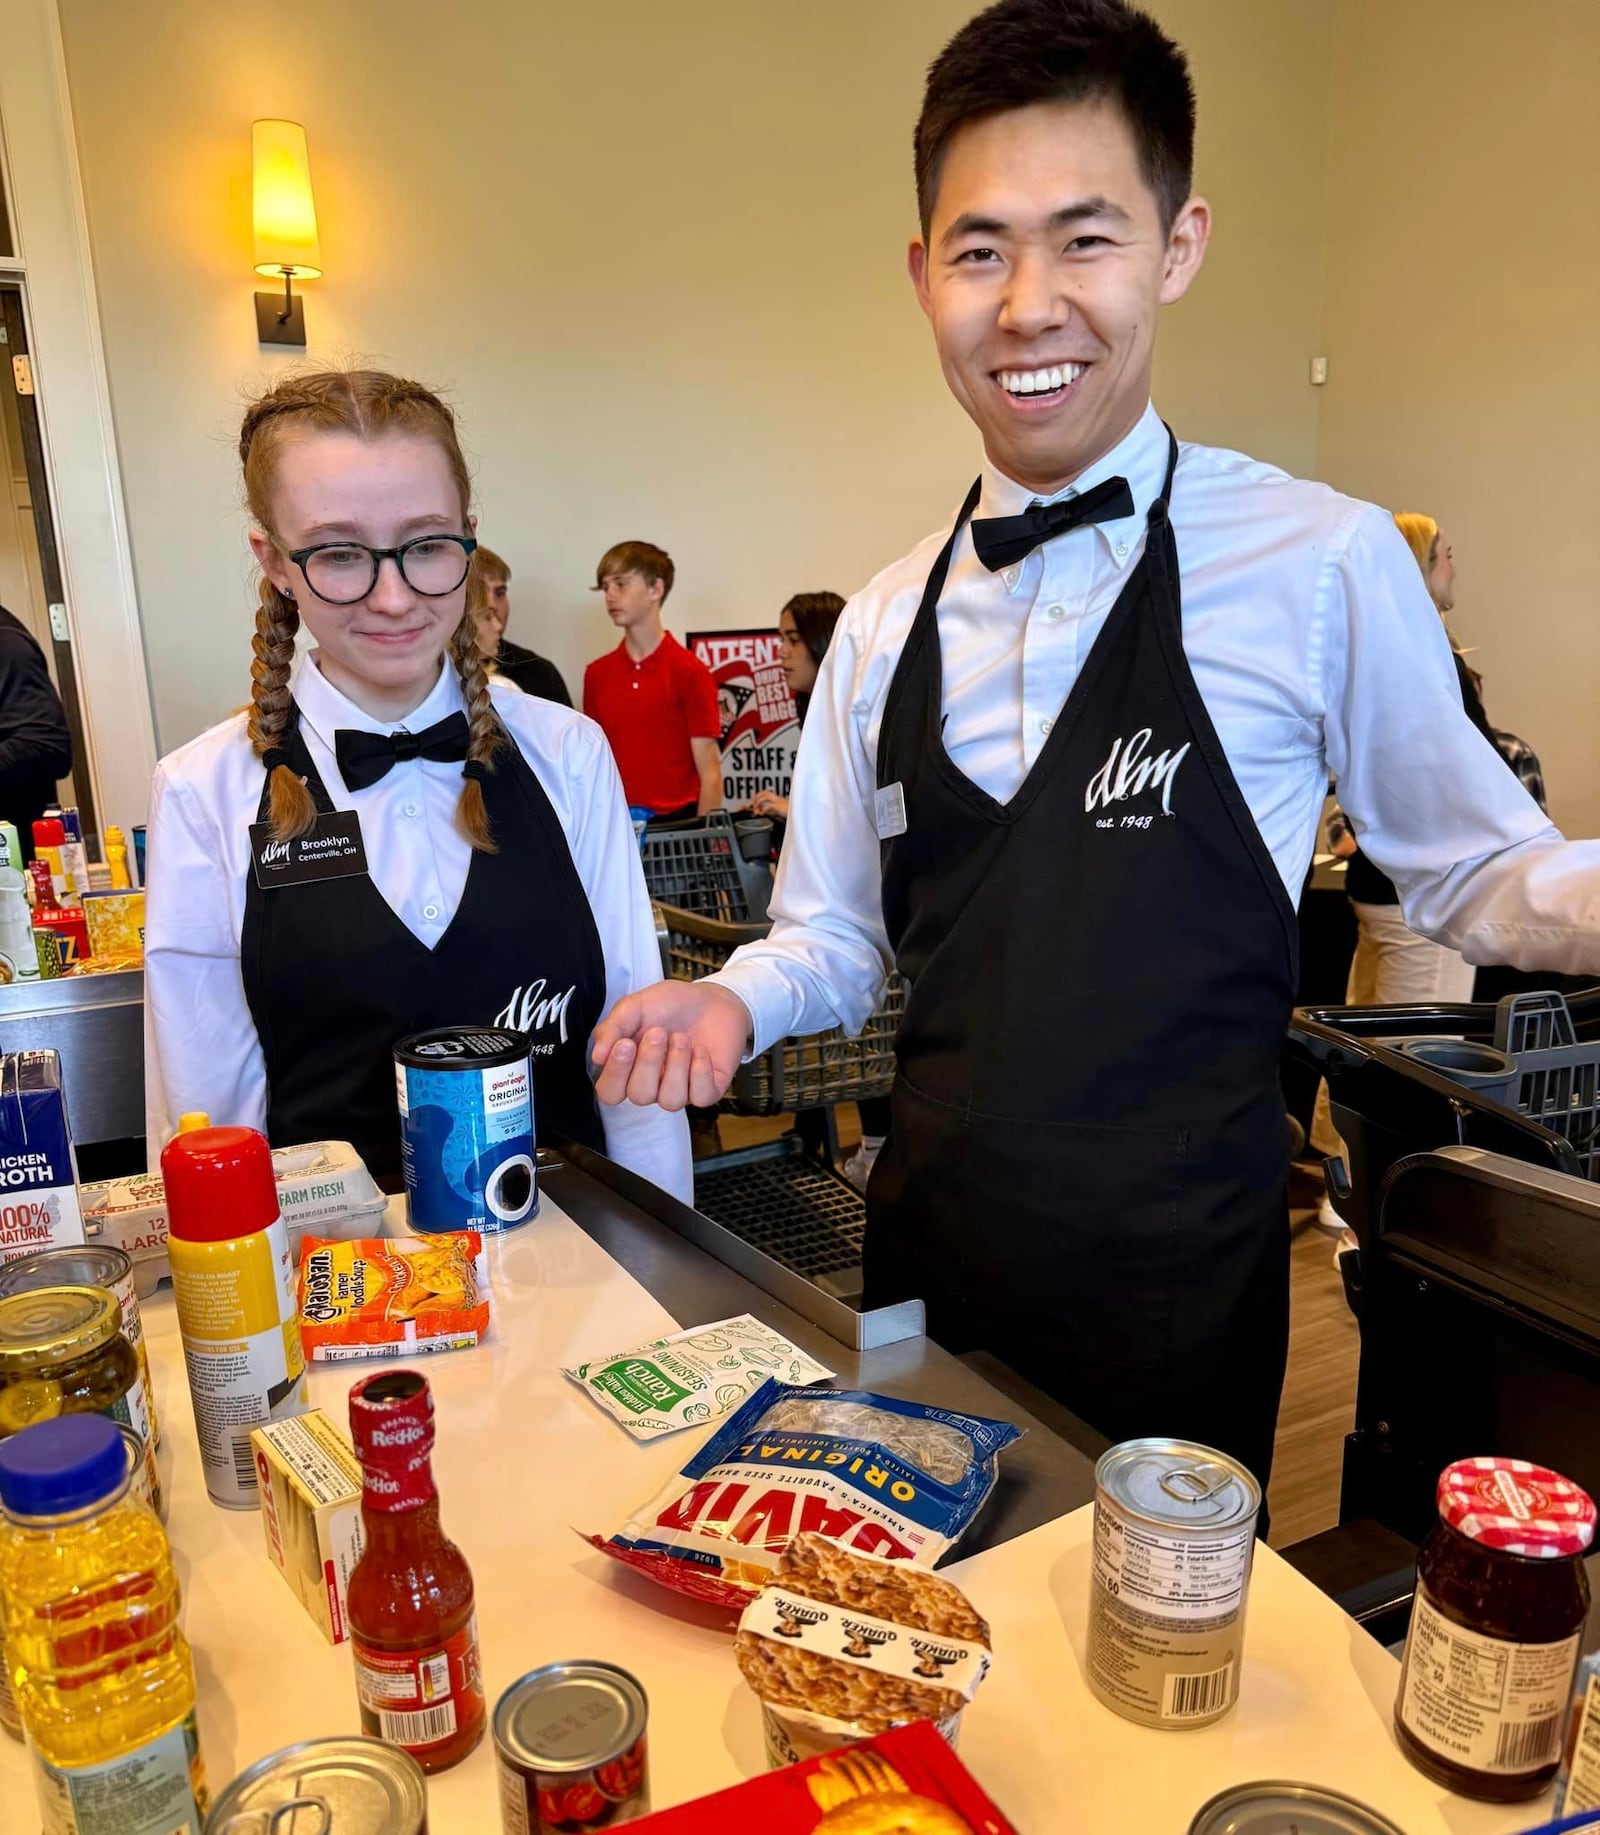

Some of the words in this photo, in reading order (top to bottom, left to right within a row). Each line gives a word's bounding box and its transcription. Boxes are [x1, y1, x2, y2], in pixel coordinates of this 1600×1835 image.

[757, 681, 789, 704] BEST
[732, 748, 784, 771] STAFF
[1096, 819, 1115, 829] est.
[1120, 816, 1153, 829] 1948
[301, 836, 350, 850] Brooklyn
[298, 849, 343, 862] Centerville,
[344, 847, 357, 855] OH
[489, 1084, 528, 1102] ORIGINAL
[0, 1153, 47, 1169] ICKEN
[279, 1188, 309, 1206] FARM
[311, 1181, 345, 1200] FRESH
[148, 1217, 166, 1231] 12
[652, 1351, 707, 1391] SEASONING
[602, 1372, 624, 1393] Valley
[624, 1362, 679, 1403] Ranch
[621, 1389, 650, 1412] Hidden
[371, 1425, 425, 1447] RedHot
[780, 1437, 829, 1447] SUNFLOWER
[706, 1468, 738, 1478] BRAN
[740, 1444, 916, 1502] ORIGINAL
[743, 1469, 774, 1481] SEED
[884, 1459, 916, 1481] SALTED
[777, 1474, 837, 1492] FAVORITE
[656, 1481, 916, 1560] DAVID
[840, 1491, 905, 1533] AMERICA'S
[1107, 1578, 1119, 1595] 60
[774, 1596, 829, 1623] QUAKER
[840, 1618, 897, 1642] QUAKER
[910, 1637, 968, 1661] QUAKER
[1433, 1669, 1445, 1684] 50
